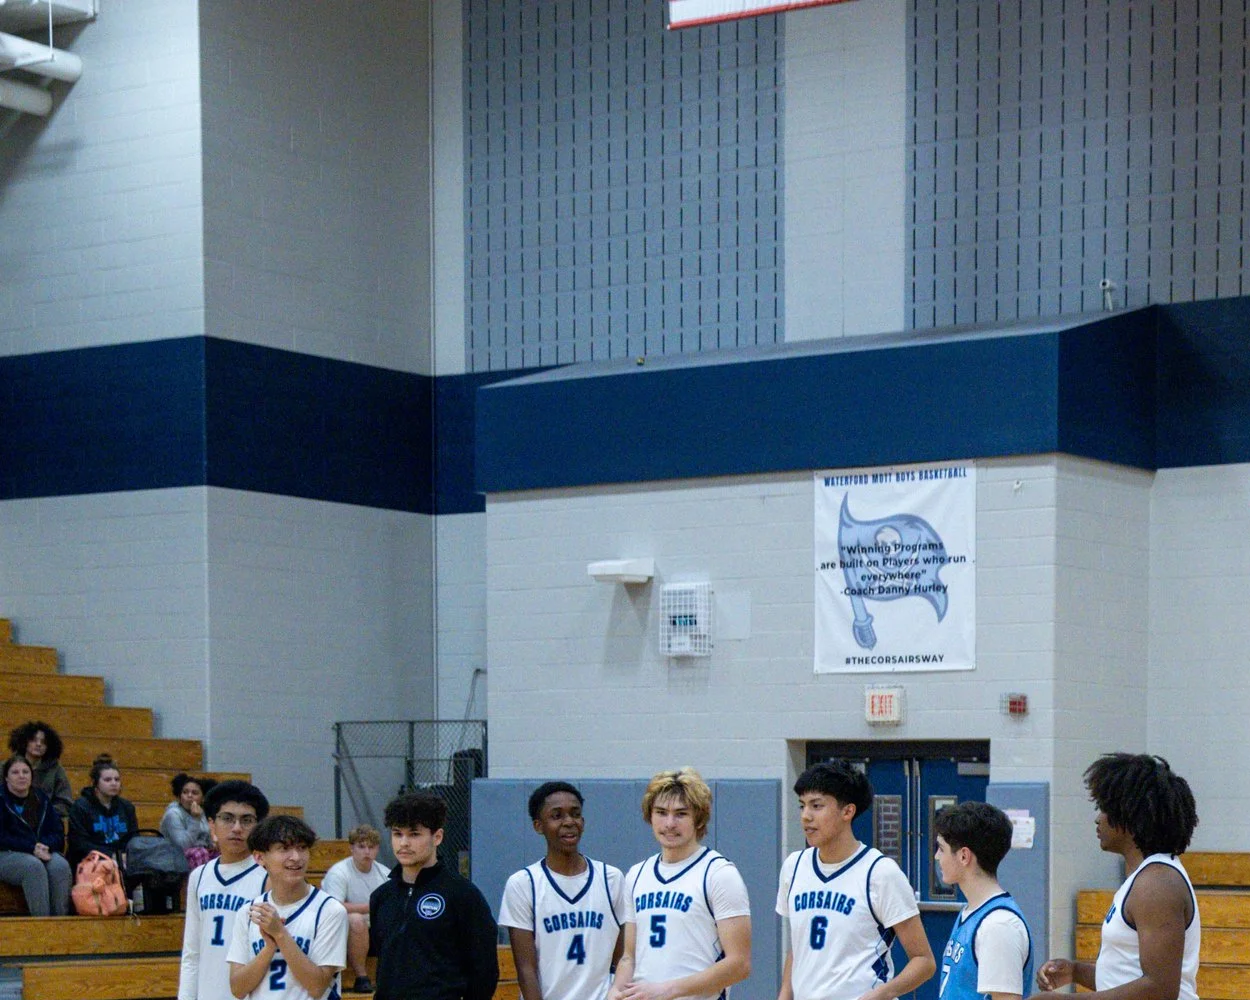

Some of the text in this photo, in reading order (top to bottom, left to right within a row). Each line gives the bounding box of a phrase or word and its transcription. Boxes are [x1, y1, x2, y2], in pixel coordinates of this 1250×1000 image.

[824, 467, 967, 487] WATERFORD MOTT BOYS BASKETBALL
[841, 542, 944, 555] "Winning Programs
[820, 555, 966, 570] are built on Players who run
[861, 571, 926, 583] everywhere"
[878, 586, 910, 596] Danny
[914, 584, 949, 594] Hurley
[845, 654, 944, 665] #THECORSAIRSWAY
[870, 693, 894, 717] EXIT
[200, 894, 251, 912] CORSAIR
[635, 891, 693, 913] CORSAIRS
[794, 890, 856, 915] CORSAIRS
[211, 915, 224, 946] 1
[543, 911, 604, 934] CORSAIRS
[649, 914, 667, 948] 5
[809, 915, 829, 950] 6
[566, 934, 586, 965] 4
[269, 959, 287, 991] 2
